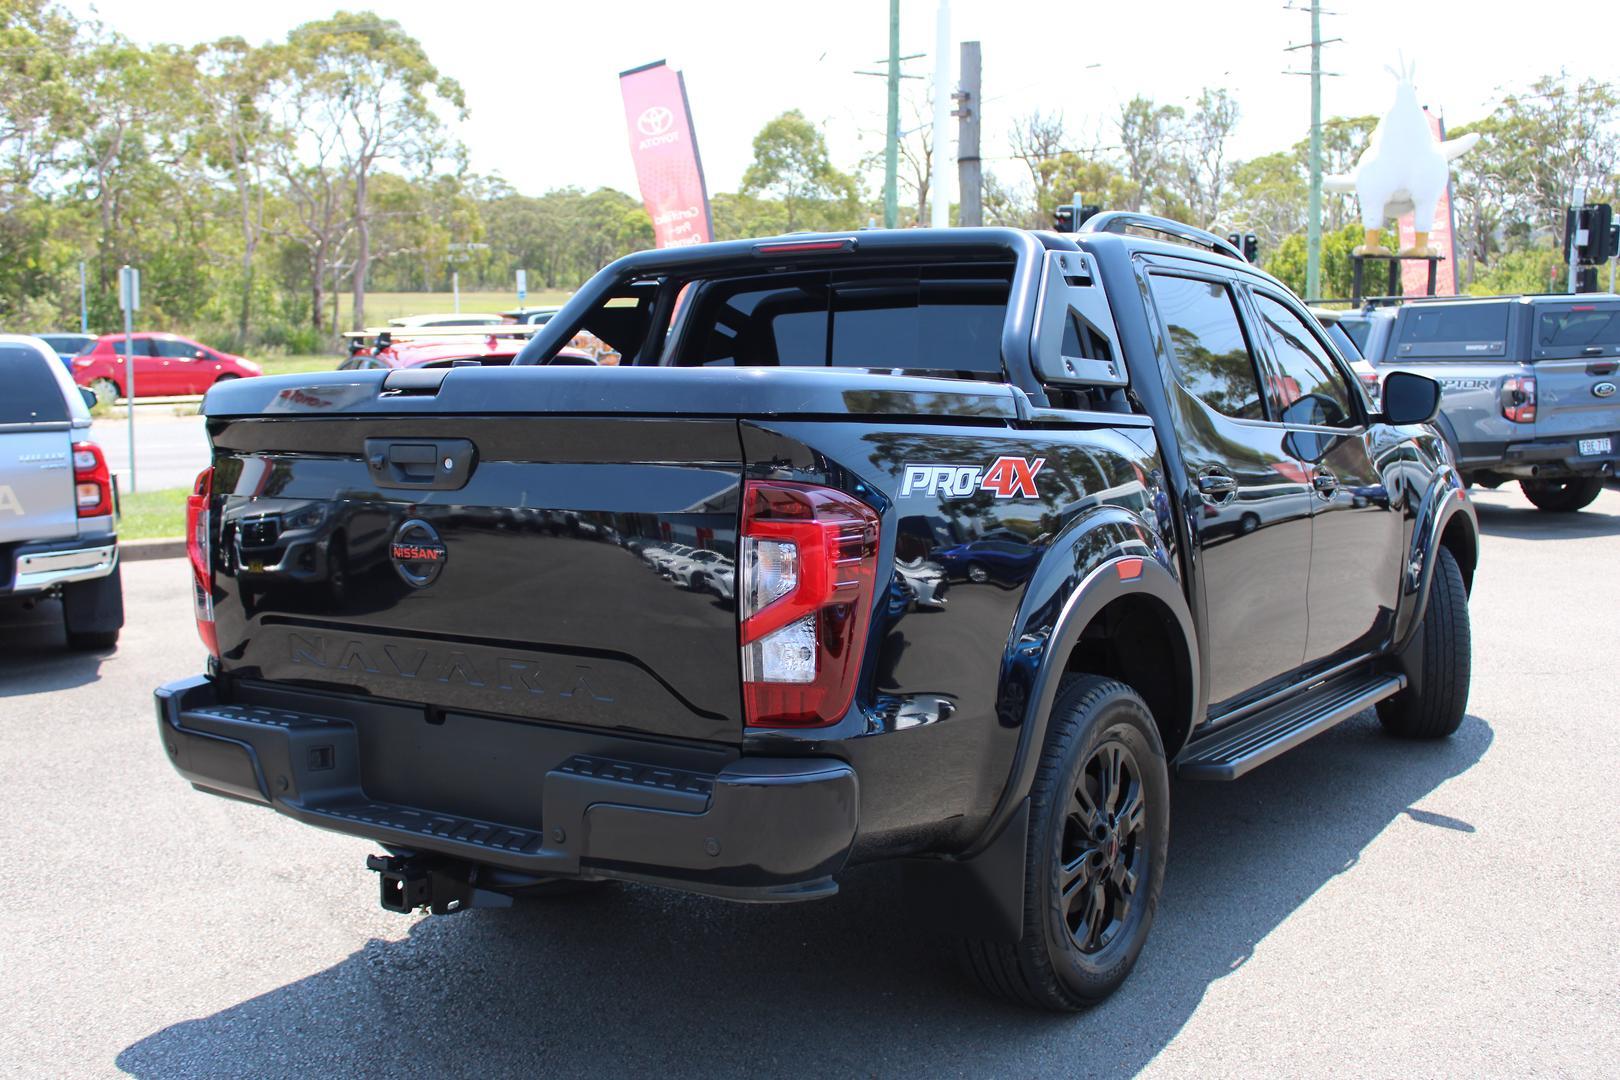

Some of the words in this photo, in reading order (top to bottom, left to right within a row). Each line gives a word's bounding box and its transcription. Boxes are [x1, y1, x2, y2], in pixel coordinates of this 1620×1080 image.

[900, 455, 1046, 499] PRO-4X
[393, 547, 437, 559] NISSAN
[288, 632, 614, 702] NAVARA
